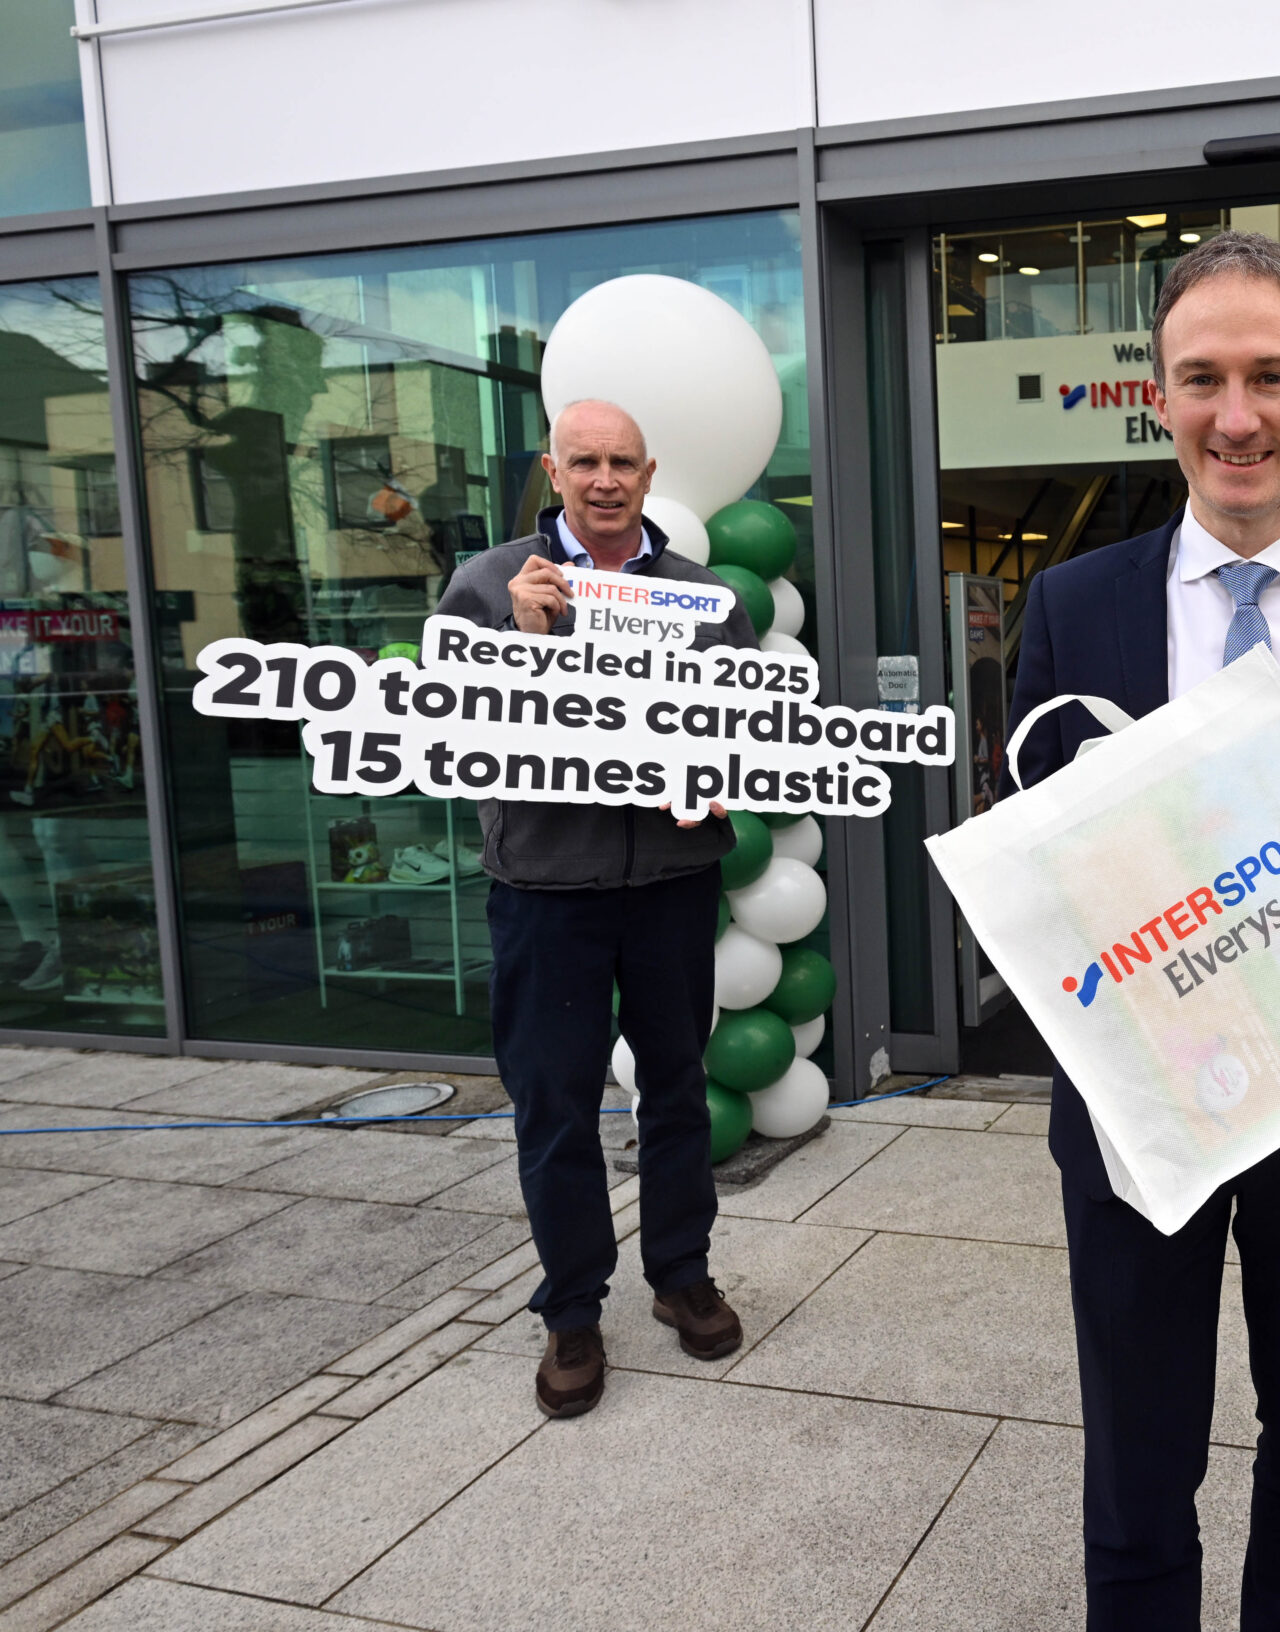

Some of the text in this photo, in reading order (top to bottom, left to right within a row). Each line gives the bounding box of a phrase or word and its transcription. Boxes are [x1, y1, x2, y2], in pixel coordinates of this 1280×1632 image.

[1125, 411, 1174, 444] Elv
[578, 580, 721, 613] INTERSPORT
[0, 614, 115, 636] KE IT YOUR
[589, 607, 684, 642] Elverys
[438, 628, 811, 695] Recycled in 2025
[211, 652, 947, 756] 210 tonnes cardboard
[320, 730, 882, 810] 15 tonnes plastic
